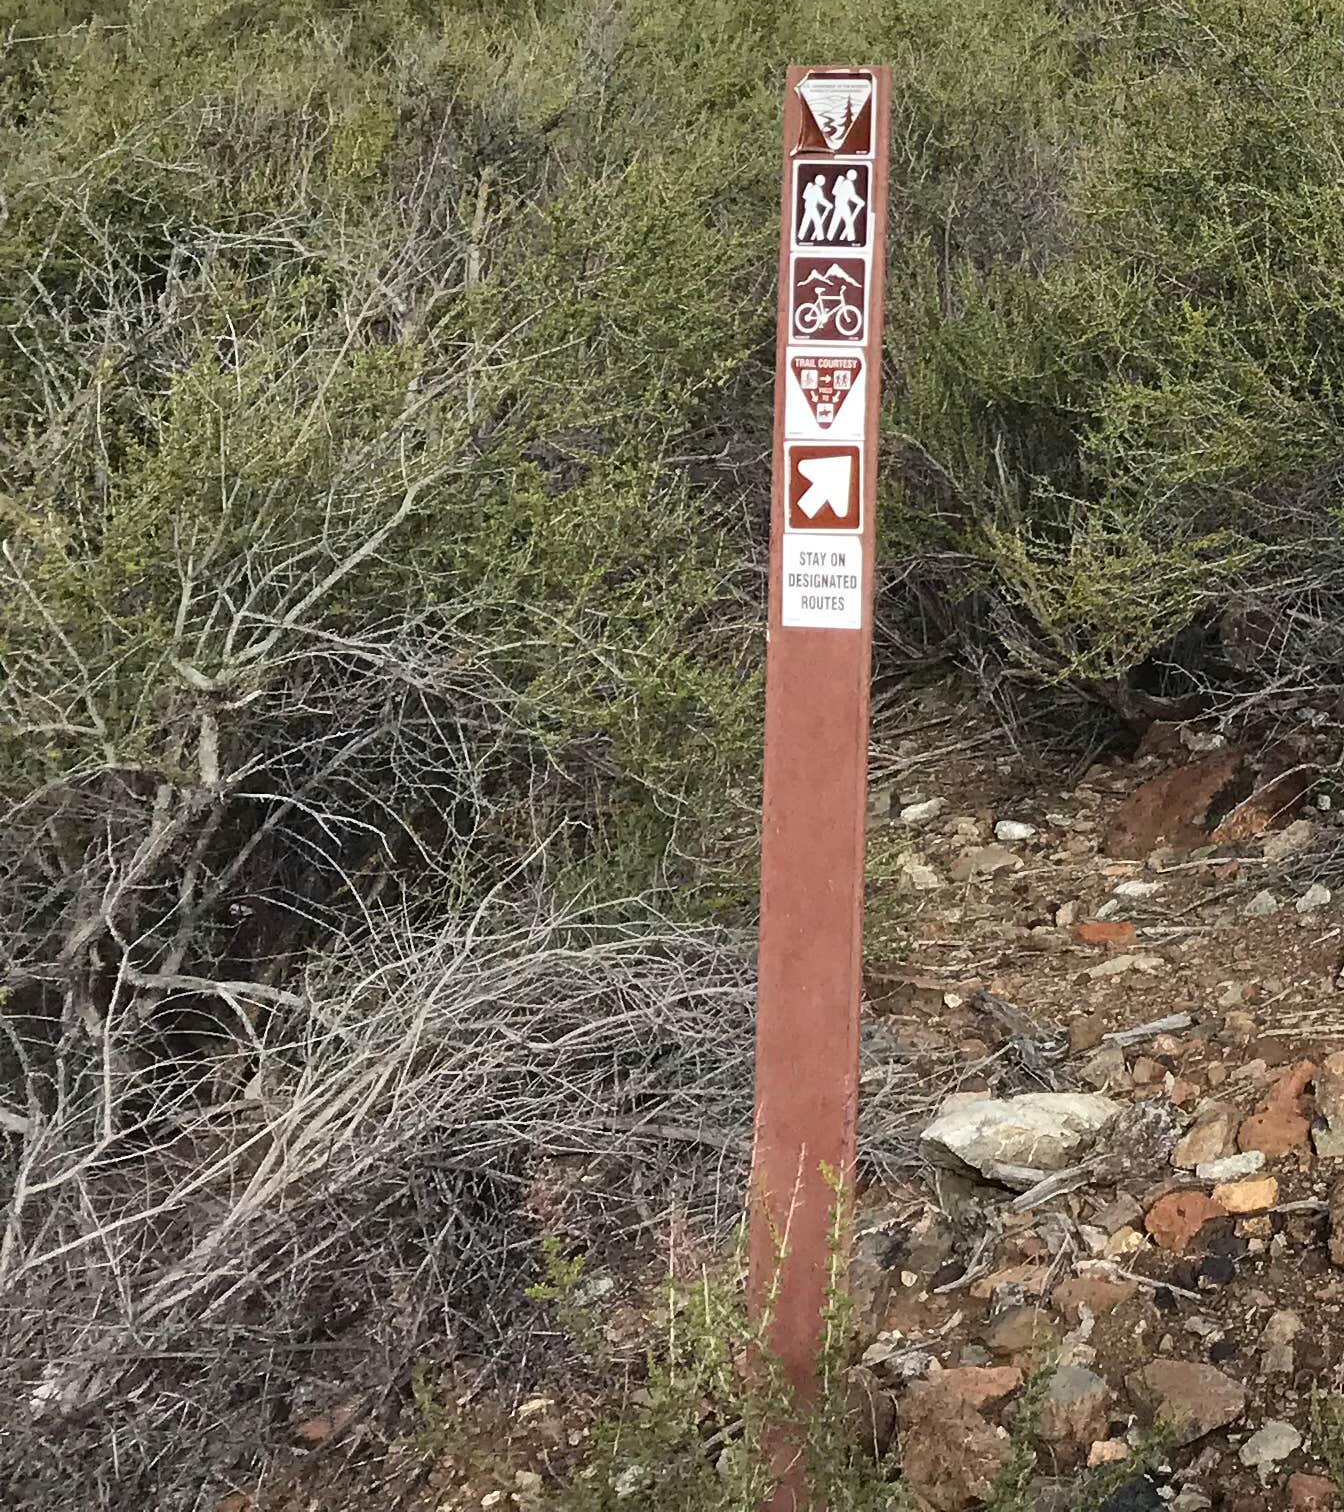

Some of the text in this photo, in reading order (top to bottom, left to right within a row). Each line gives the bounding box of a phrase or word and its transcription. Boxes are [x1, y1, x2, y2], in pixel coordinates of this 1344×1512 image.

[795, 358, 858, 369] TRAIL COURTESY
[799, 551, 846, 567] STAY ON
[788, 573, 857, 589] DESIGNATED
[801, 595, 845, 611] ROUTES
